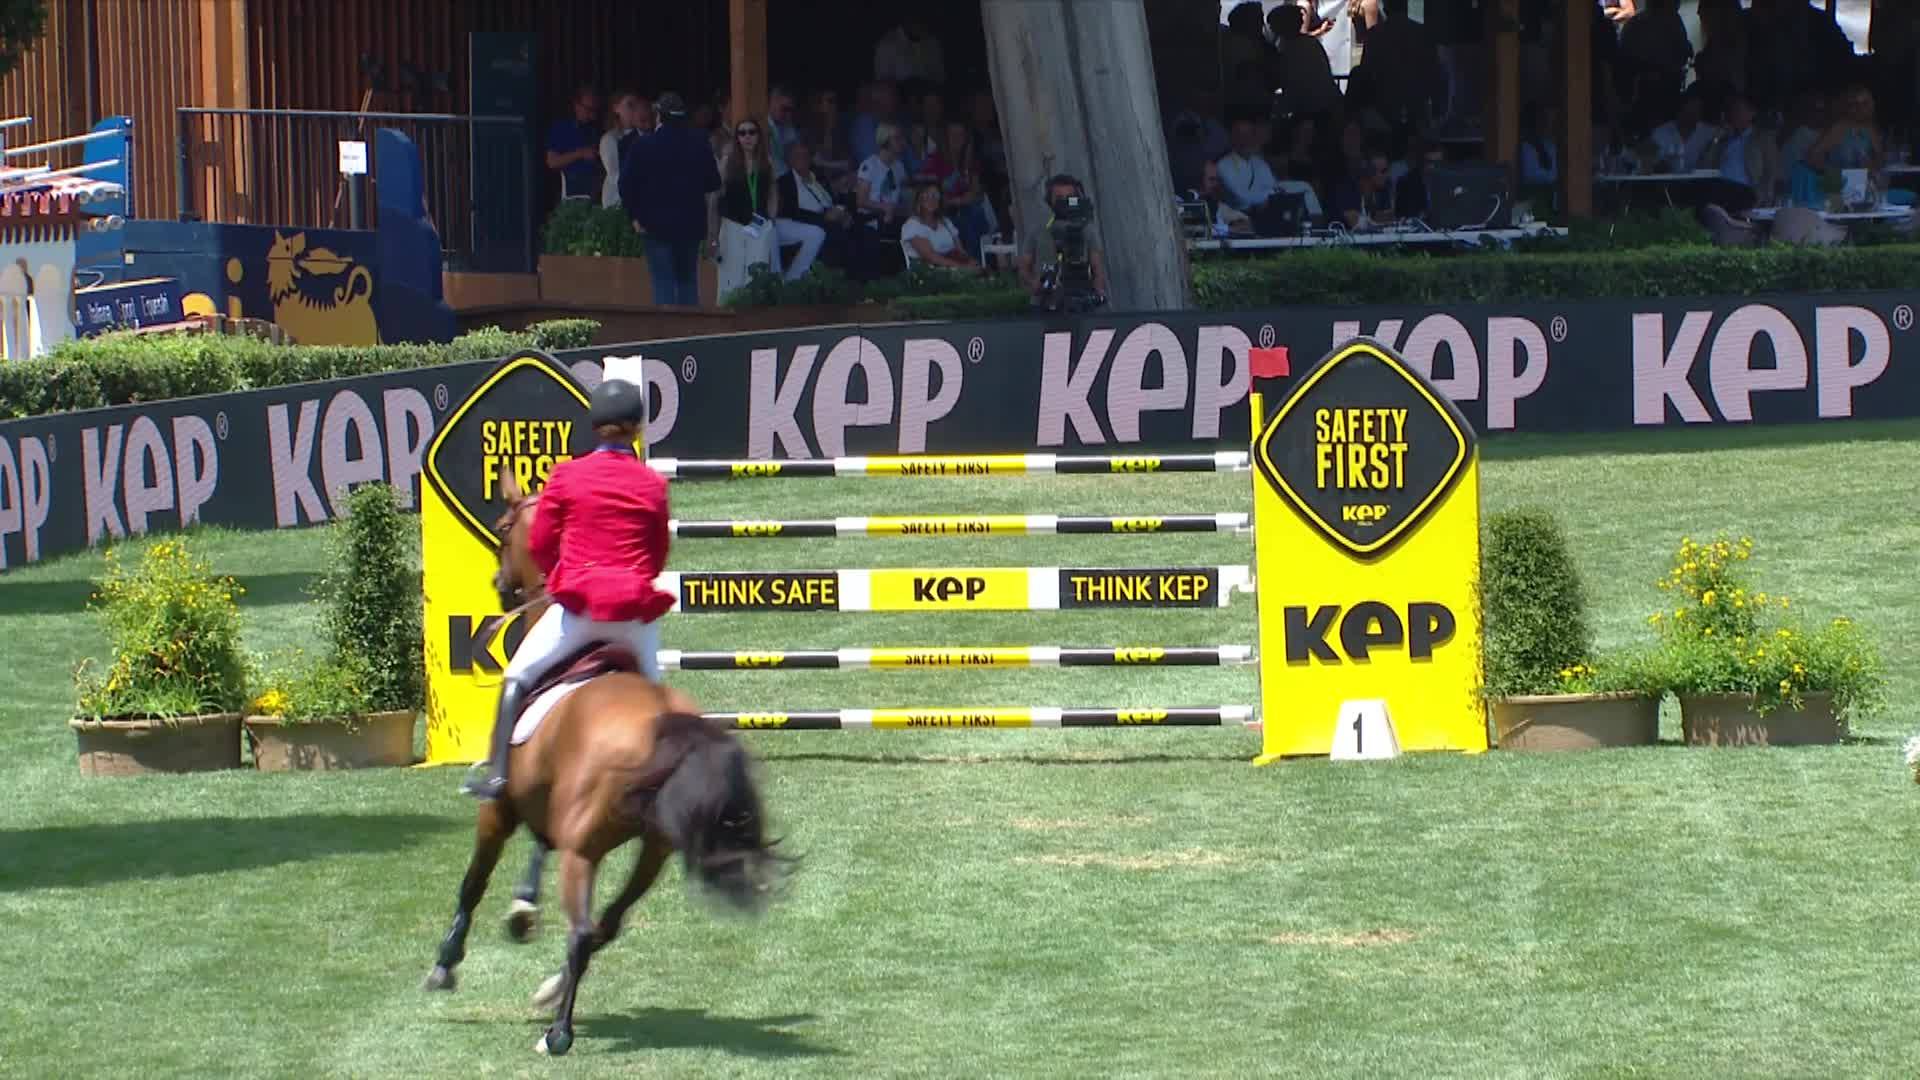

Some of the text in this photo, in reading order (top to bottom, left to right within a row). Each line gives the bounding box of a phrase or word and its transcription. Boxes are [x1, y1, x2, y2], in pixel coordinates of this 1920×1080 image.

[483, 420, 573, 455] SAFETY
[1315, 408, 1408, 442] SAFETY
[1316, 443, 1408, 489] FIRST
[684, 578, 766, 606] THINK
[771, 578, 835, 606] SAFE
[1071, 575, 1153, 602] THINK
[1159, 574, 1209, 601] KEP
[1352, 712, 1363, 754] 1
